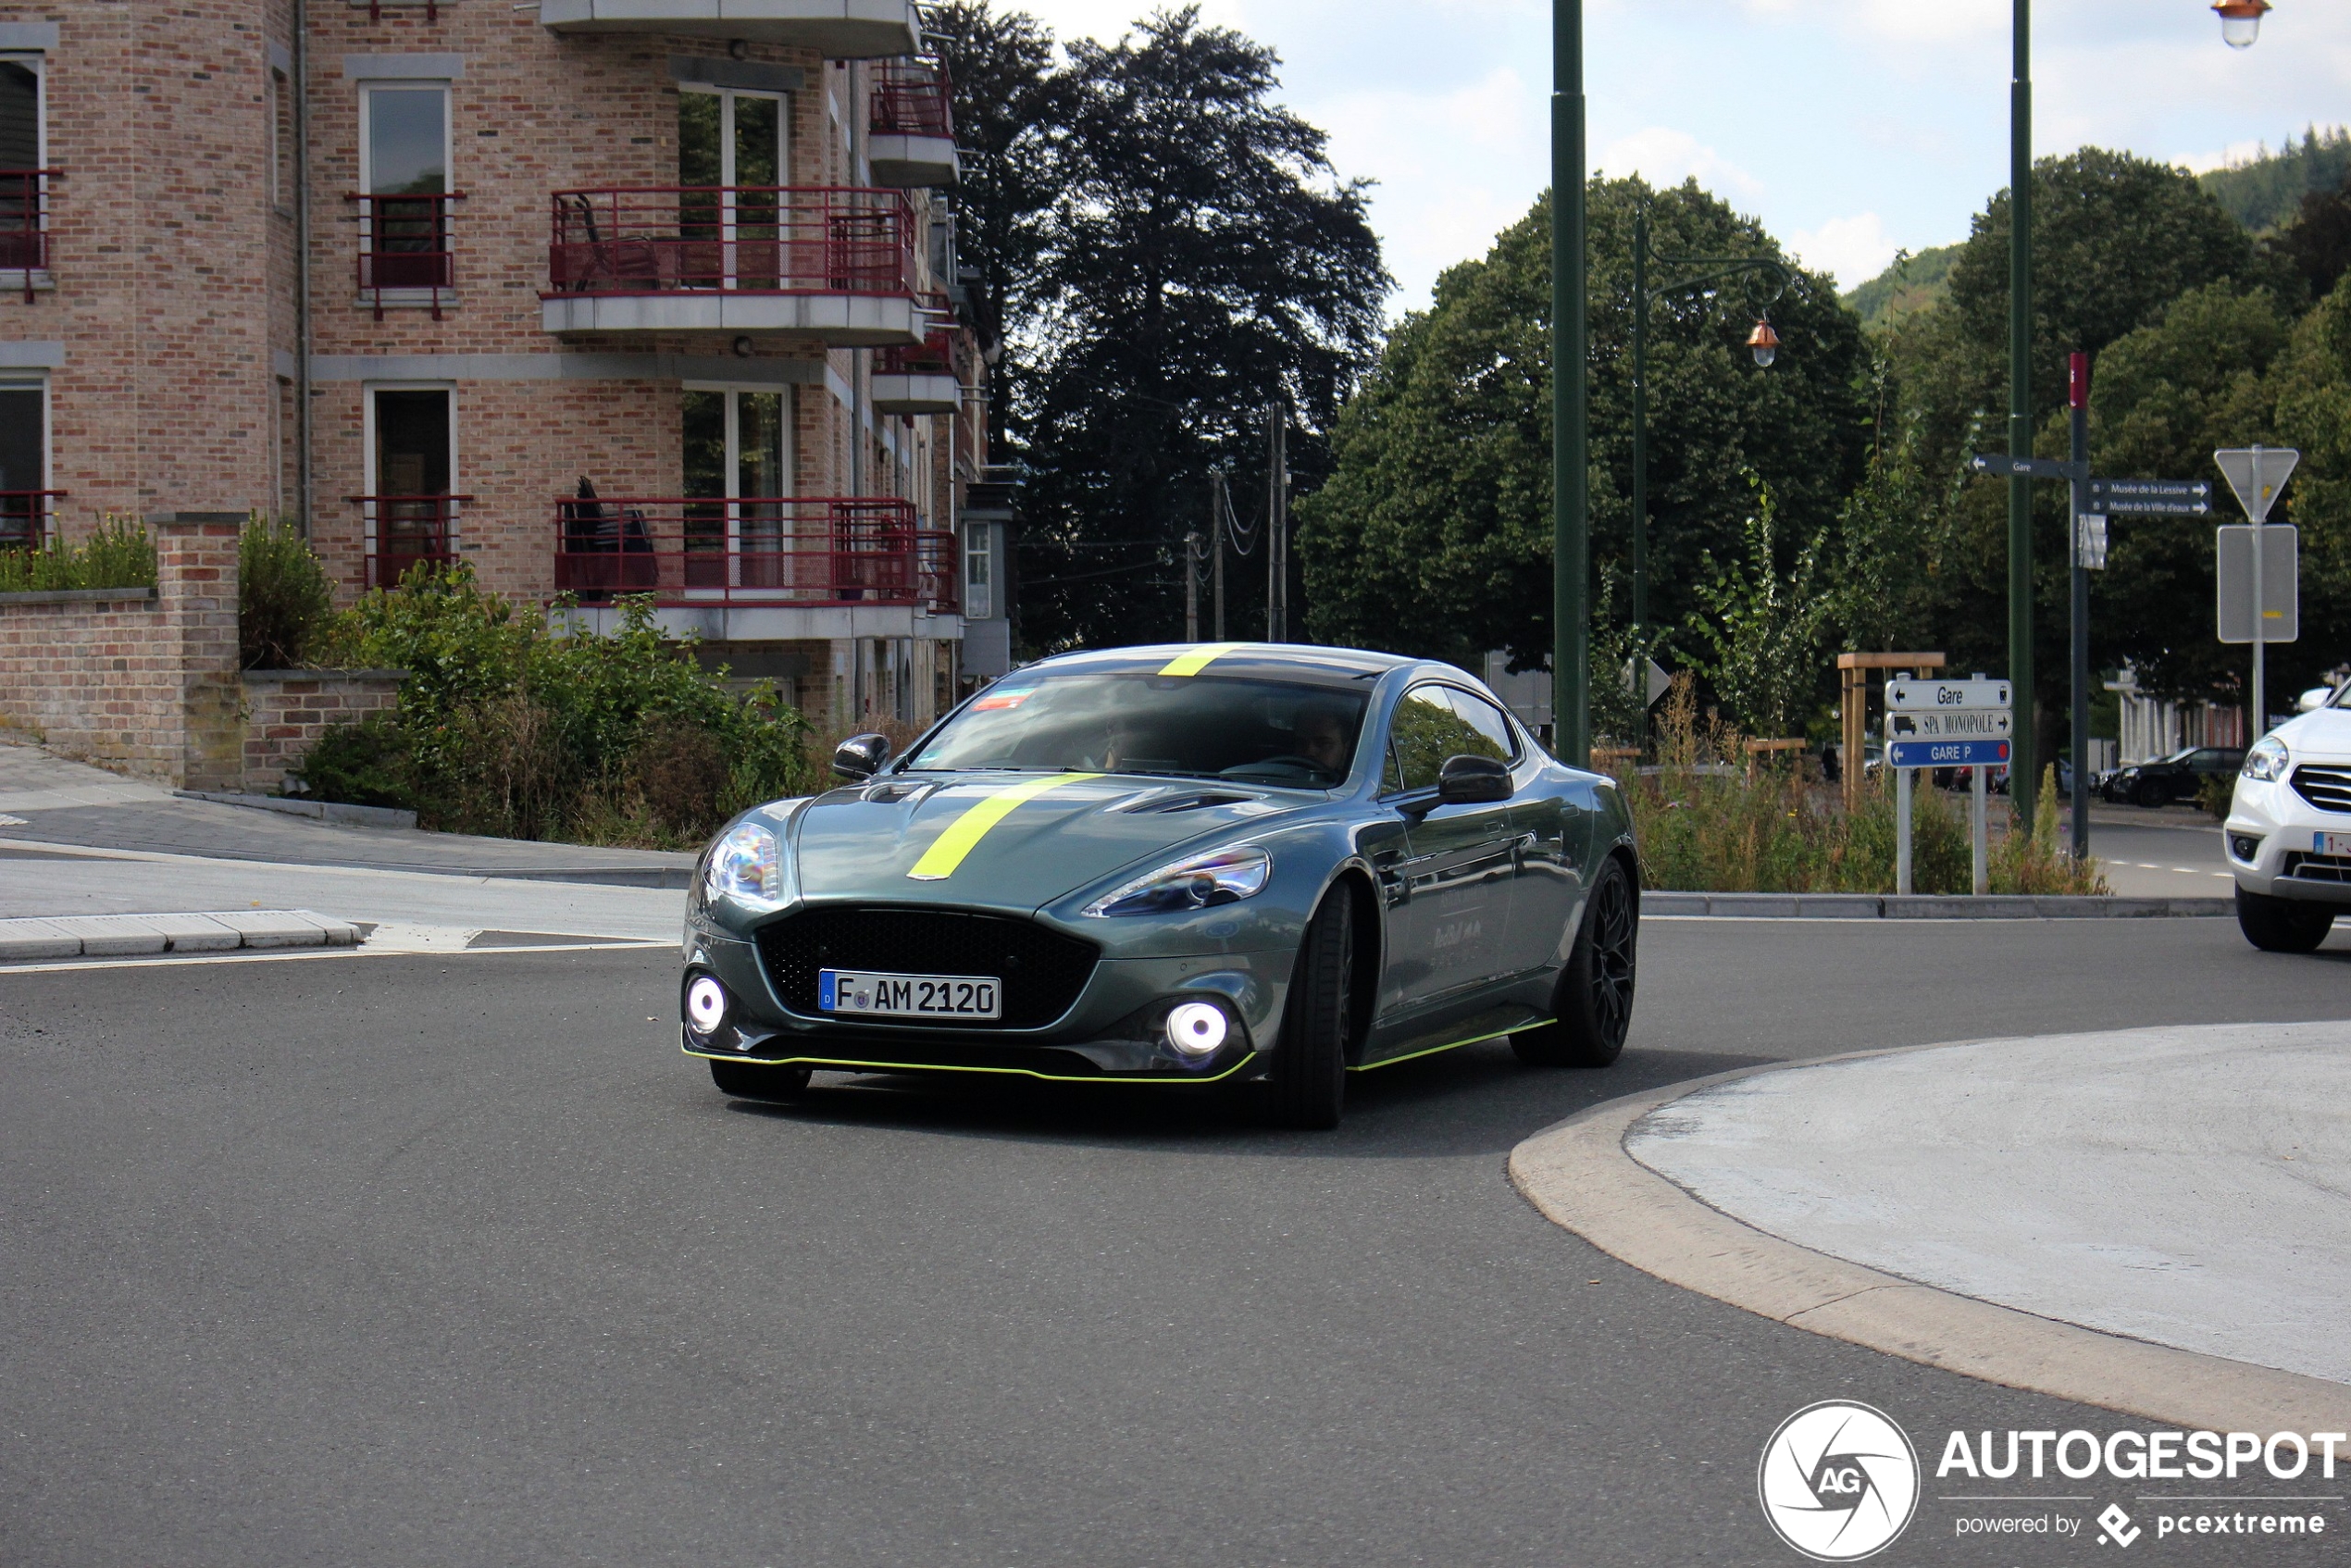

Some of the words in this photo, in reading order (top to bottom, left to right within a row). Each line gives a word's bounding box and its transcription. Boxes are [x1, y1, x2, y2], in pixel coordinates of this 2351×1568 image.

[2013, 462, 2031, 472] Gare
[2111, 483, 2137, 493] Musée
[2139, 484, 2149, 493] de
[2150, 484, 2158, 494] la
[2159, 485, 2188, 495] Lessive
[2109, 501, 2133, 511] Musée
[2133, 502, 2143, 511] de
[2144, 502, 2150, 511] la
[1937, 686, 1963, 704] Gare
[1924, 716, 1939, 735] SPA
[1945, 714, 1994, 734] MONOPOLE
[1931, 746, 1959, 761] GARE
[1964, 746, 1972, 758] P
[824, 994, 830, 1004] D
